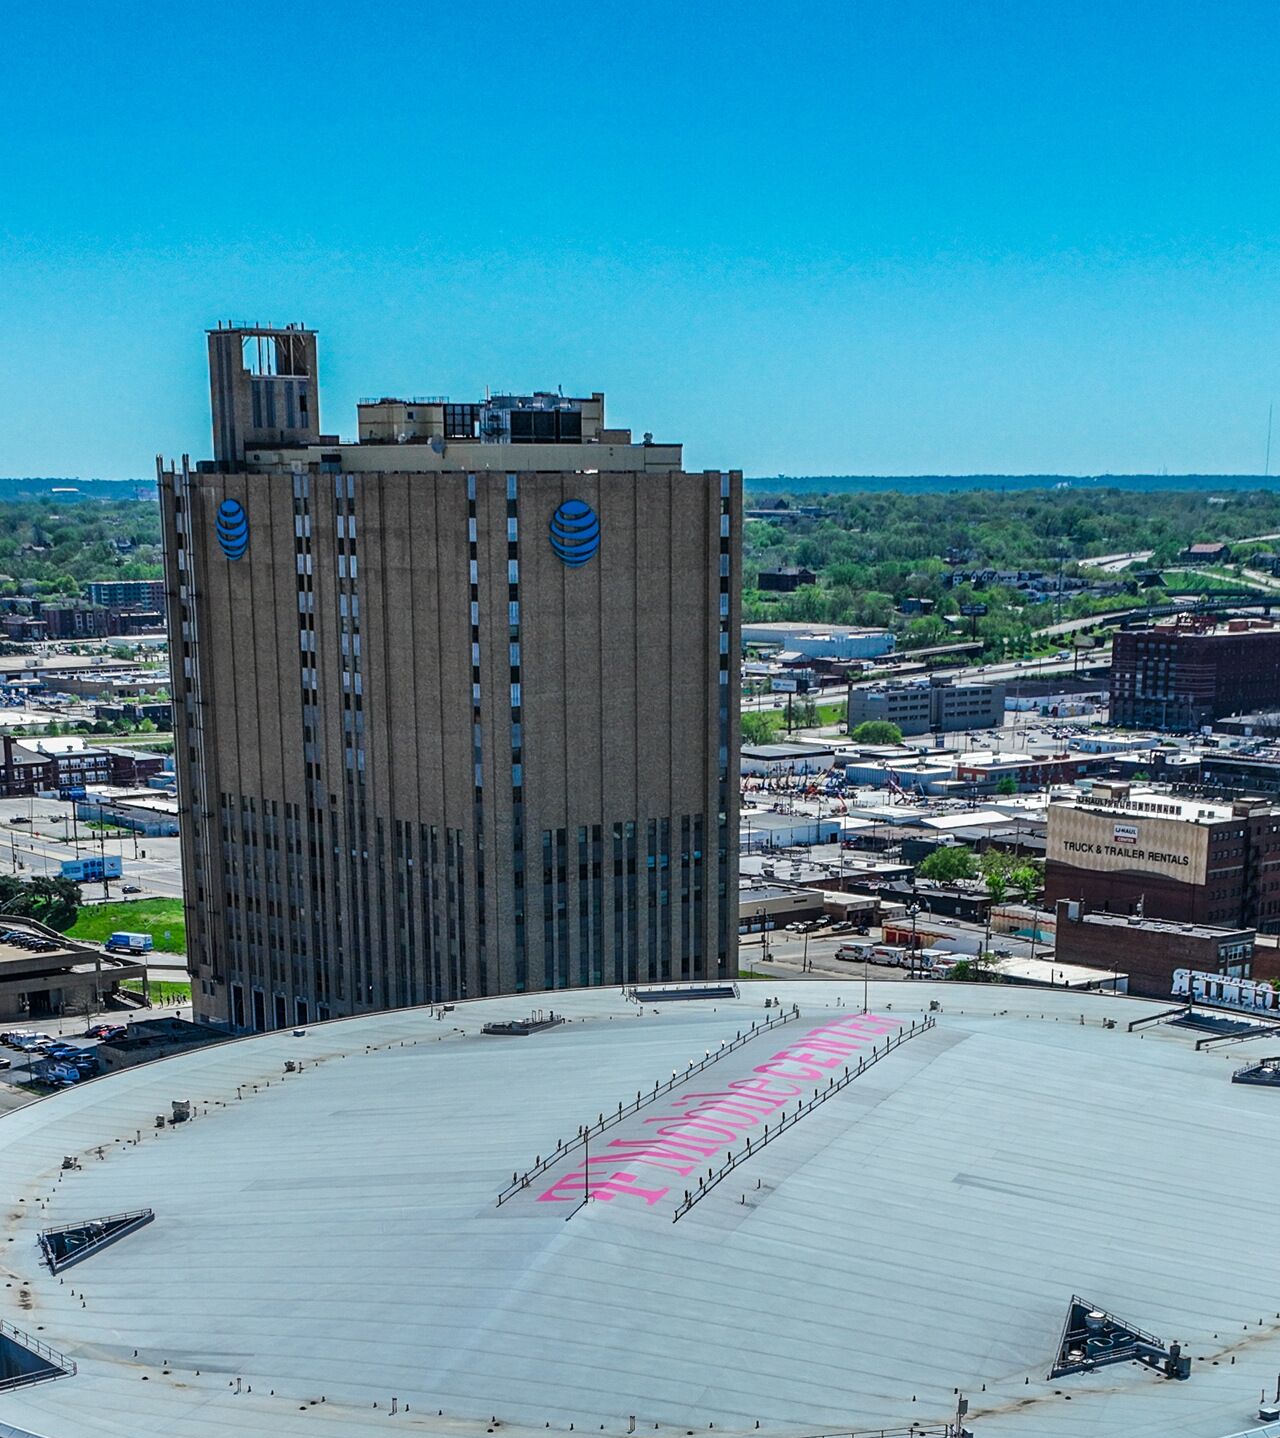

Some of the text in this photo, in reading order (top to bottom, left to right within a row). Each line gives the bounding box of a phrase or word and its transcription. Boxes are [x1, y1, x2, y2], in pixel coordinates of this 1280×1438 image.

[1064, 841, 1190, 866] TRUCK & TRAILER RENTALS
[578, 1078, 802, 1177] Mobile
[753, 1013, 906, 1081] CENTER
